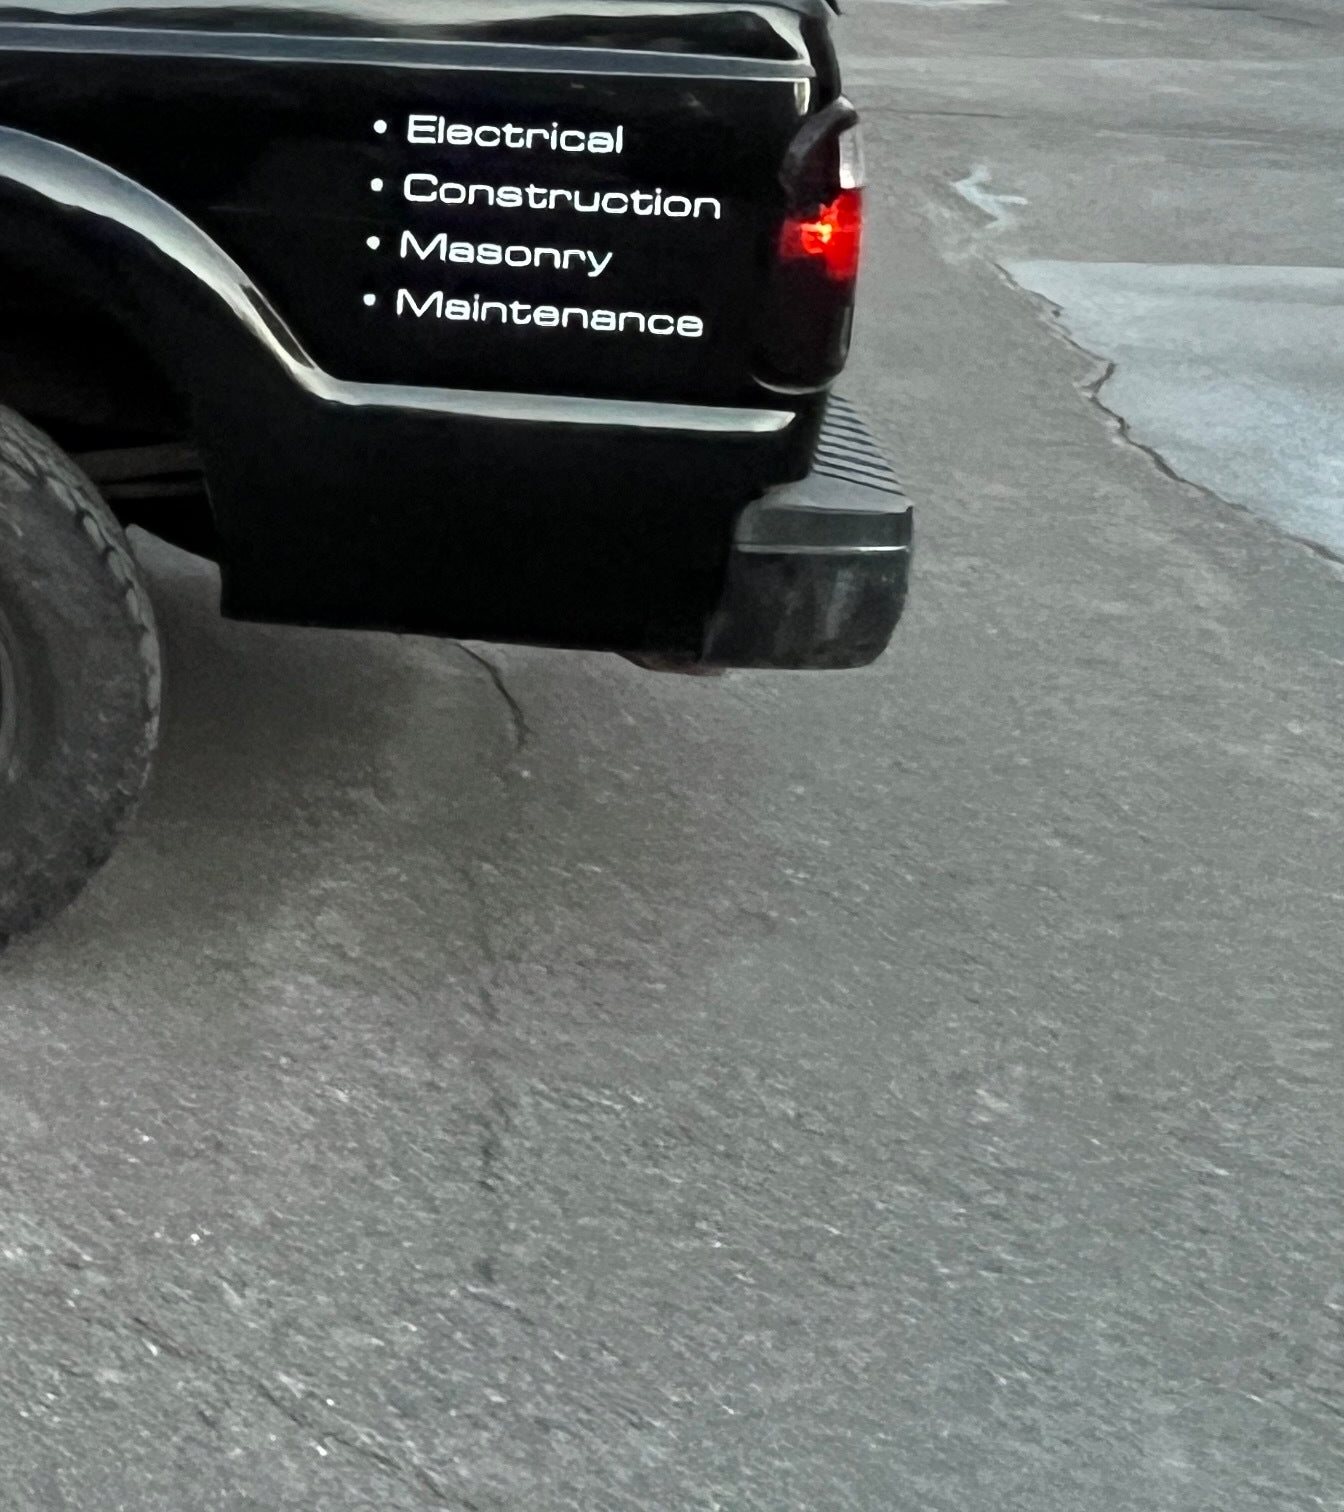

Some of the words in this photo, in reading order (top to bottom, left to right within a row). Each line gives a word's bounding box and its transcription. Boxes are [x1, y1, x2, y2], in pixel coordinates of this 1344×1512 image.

[406, 114, 625, 155] Electrical
[403, 173, 721, 219] Construction
[400, 230, 613, 277] Masonry
[395, 287, 705, 338] Maintenance
